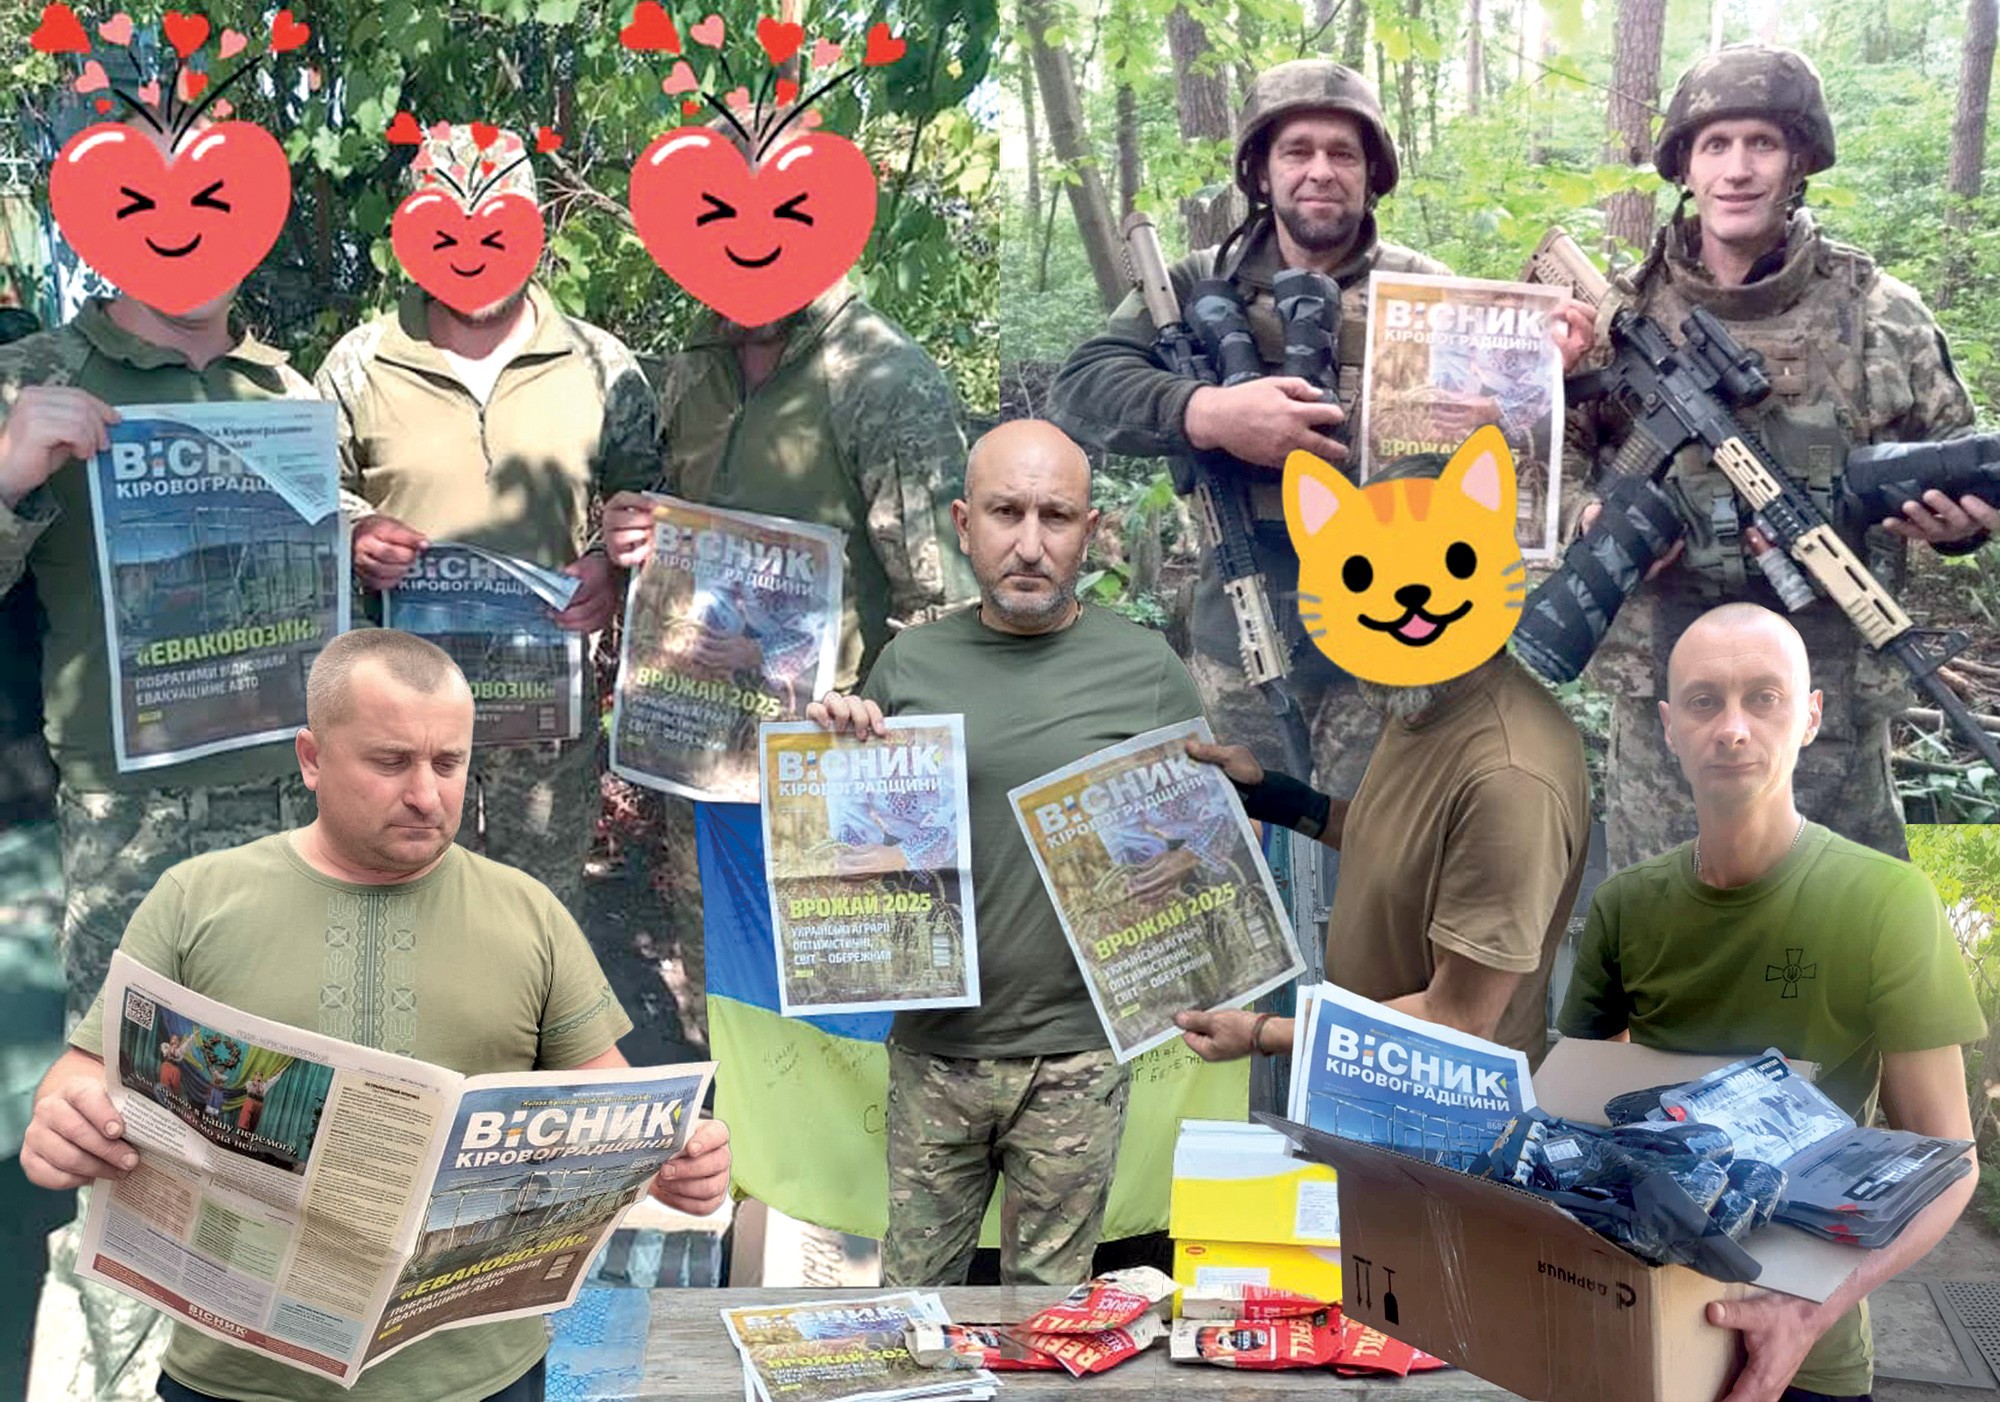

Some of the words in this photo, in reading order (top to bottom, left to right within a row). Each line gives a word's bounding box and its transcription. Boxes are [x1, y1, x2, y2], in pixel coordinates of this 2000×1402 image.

[112, 439, 245, 480] ВІСН
[116, 474, 279, 499] КІРОВОГРАДЩ
[229, 676, 259, 690] АВТО
[469, 682, 555, 699] ОВОЗИК»
[637, 668, 724, 702] ВРОЖАЙ
[730, 689, 781, 717] 2025
[789, 893, 879, 920] ВРОЖАЙ
[883, 892, 932, 914] 2025
[1093, 903, 1185, 960] ВРОЖАЙ
[1189, 881, 1237, 916] 2025
[1326, 1058, 1510, 1112] КІРОВОГРАДЩИНИ
[237, 1128, 299, 1157] перемогу,
[455, 1137, 673, 1169] КІРОВОГРАДЩИНИ
[400, 1234, 588, 1300] «ЕВАКОВОЗИК»
[384, 1291, 471, 1329] ЕВАКУАЦІЙНЕ
[473, 1279, 504, 1293] АВТО
[390, 1282, 471, 1318] ПОБРАТИМИ
[472, 1260, 542, 1286] ВІДНОВИЛИ
[189, 1304, 246, 1337] ВІСНИК
[868, 1348, 909, 1361] 202
